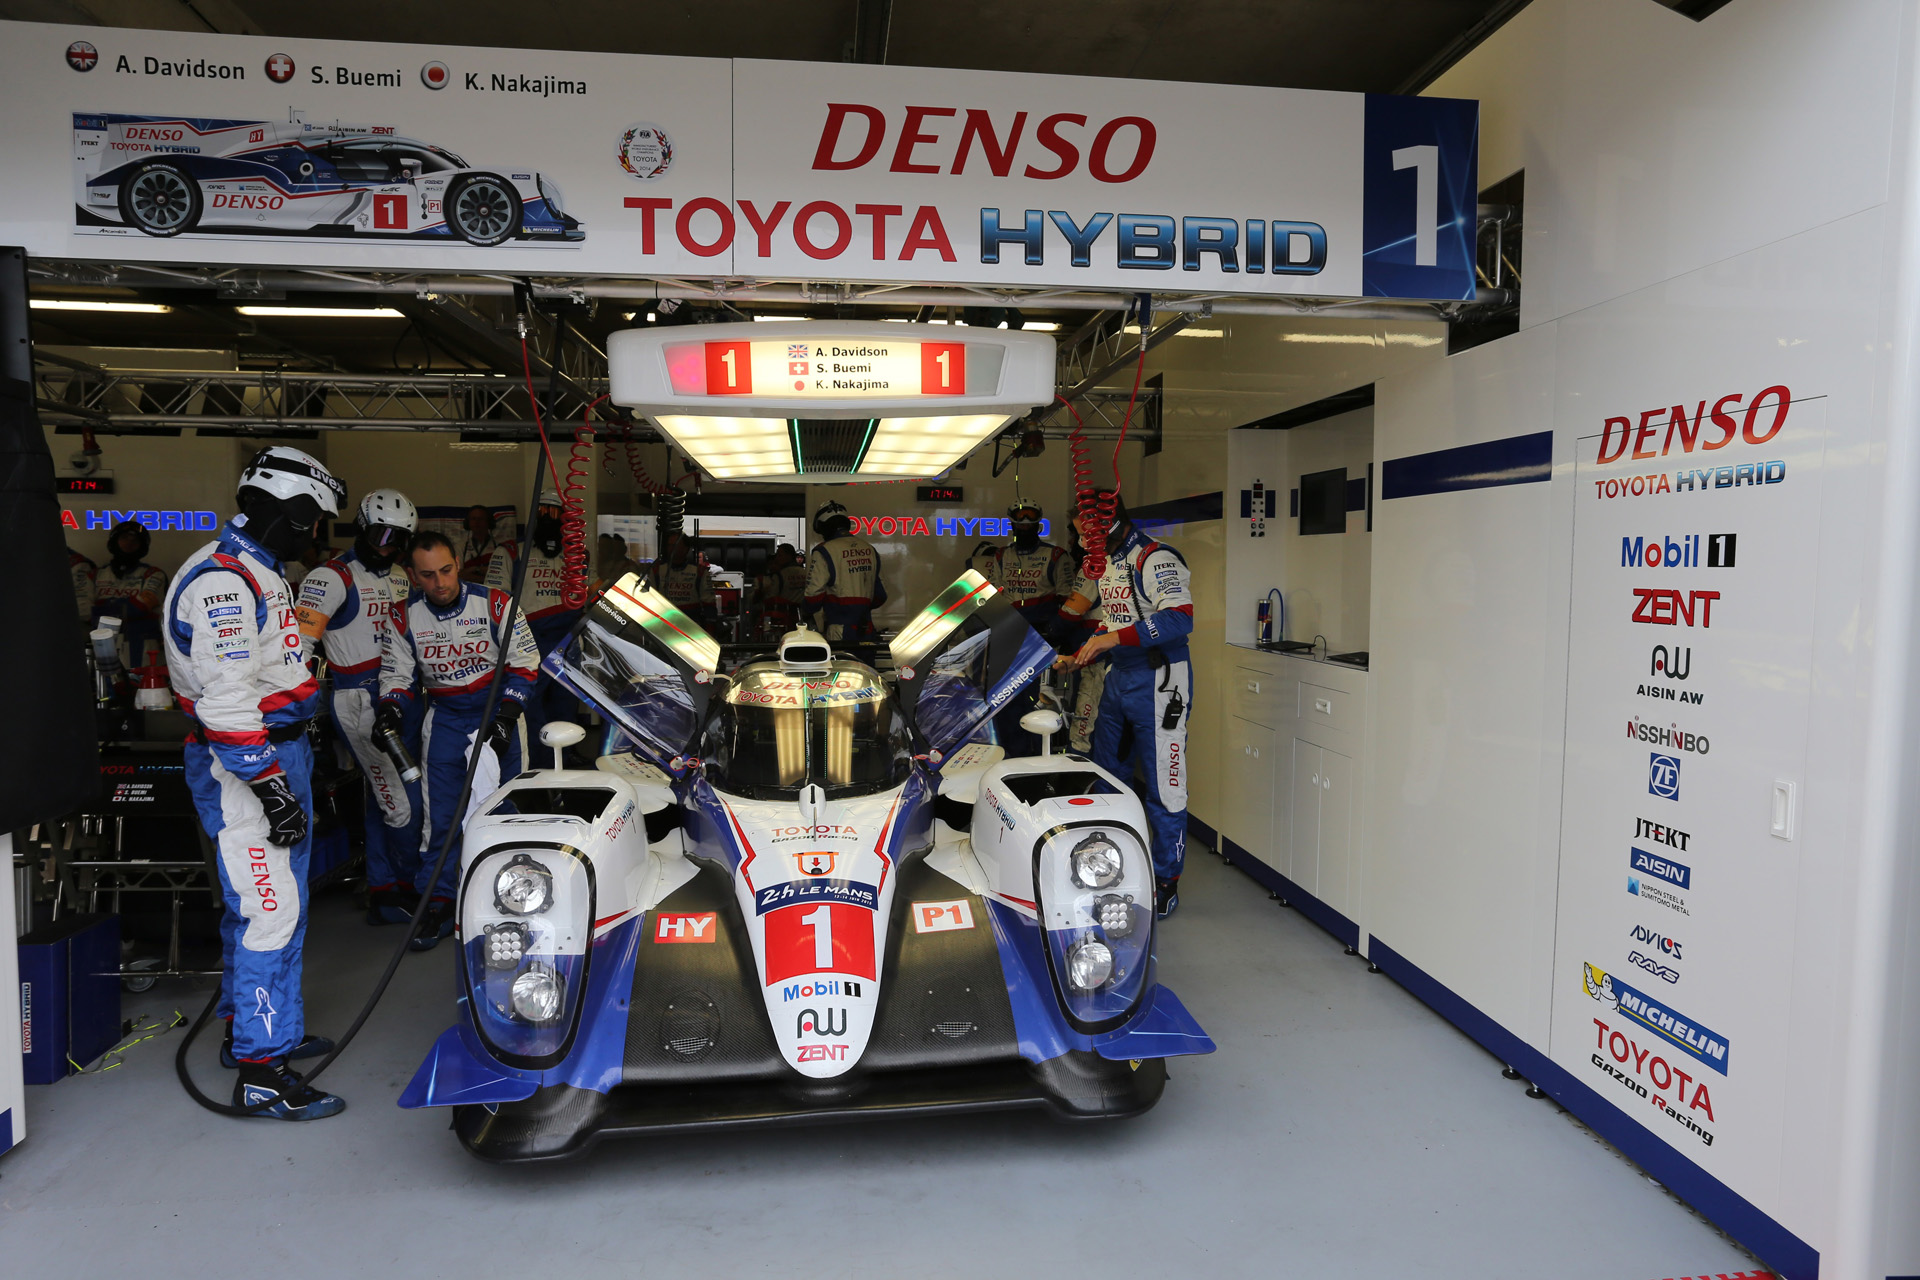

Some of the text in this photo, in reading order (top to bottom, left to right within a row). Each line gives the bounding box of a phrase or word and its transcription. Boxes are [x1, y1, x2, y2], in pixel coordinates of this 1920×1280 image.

[116, 54, 245, 80] A. Davidson
[311, 66, 401, 87] S. Buemi
[465, 72, 587, 98] K. Nakajima
[126, 127, 183, 141] DENSO
[250, 130, 263, 142] HY
[371, 126, 395, 135] ZENT
[110, 142, 200, 154] TOYOTA HYBRID
[812, 103, 1157, 184] DENSO
[212, 194, 284, 210] DENSO
[383, 200, 395, 225] 1
[430, 203, 440, 211] P1
[1392, 145, 1437, 266] 1
[624, 197, 1328, 276] TOYOTA HYBRID
[816, 347, 888, 357] A. Davidson
[721, 349, 736, 387] 1
[816, 363, 871, 373] S. Buemi
[936, 350, 950, 387] 1
[816, 379, 889, 391] K. Nakajima
[1596, 385, 1791, 464] DENSO
[310, 467, 345, 495] uvex
[1595, 460, 1786, 499] TOYOTA HYBRID
[85, 510, 218, 531] HYBRID
[848, 517, 1050, 536] OYOTA HYBRD
[842, 548, 872, 558] DENSO
[1621, 535, 1699, 568] Mobil
[846, 558, 872, 567] TOYOTA
[1154, 563, 1176, 571] JTEKT
[305, 579, 329, 587] JTEKT
[1006, 569, 1041, 578] DENSO
[98, 588, 139, 597] DENSO
[669, 582, 693, 590] ENSO
[203, 593, 239, 607] JTEKT
[300, 600, 319, 609] ZENT
[1632, 588, 1720, 628] ZENT
[211, 607, 240, 617] AISIN
[596, 600, 627, 626] NISSHINBO
[217, 627, 243, 638] ZENT
[424, 640, 489, 659] DENSO
[428, 657, 488, 673] TOYOTA
[433, 664, 489, 681] HYBRID
[735, 686, 881, 704] TOYOTA HYBRID
[762, 680, 851, 690] DENSO
[990, 666, 1035, 707] NISSHINBO
[1637, 684, 1704, 705] AISIN AW
[100, 765, 135, 774] YOTA
[1169, 742, 1180, 787] DENSO
[369, 765, 396, 811] DENSO
[985, 787, 1016, 831] TOYOTA HYBRID
[605, 816, 624, 842] TOYOTA
[771, 825, 857, 837] TOYOTA
[771, 834, 815, 843] GAZOO
[1634, 817, 1691, 851] JTEKT
[1636, 854, 1684, 883] AISIN
[248, 847, 277, 912] DENSO
[799, 886, 821, 894] LE
[824, 885, 873, 901] MANS
[1641, 891, 1690, 916] SUMITOMO METAL
[1642, 884, 1662, 896] NIPPON
[1663, 892, 1679, 904] STEEL
[658, 916, 713, 938] HY
[922, 905, 963, 928] P1
[801, 905, 834, 969] 1
[1628, 951, 1680, 984] RAYS
[783, 980, 839, 1002] Mobil
[1620, 991, 1726, 1061] MICHELIN
[797, 1044, 849, 1062] ZENT
[1593, 1018, 1714, 1123] TOYOTA
[1591, 1054, 1714, 1147] GAZOO Racing
